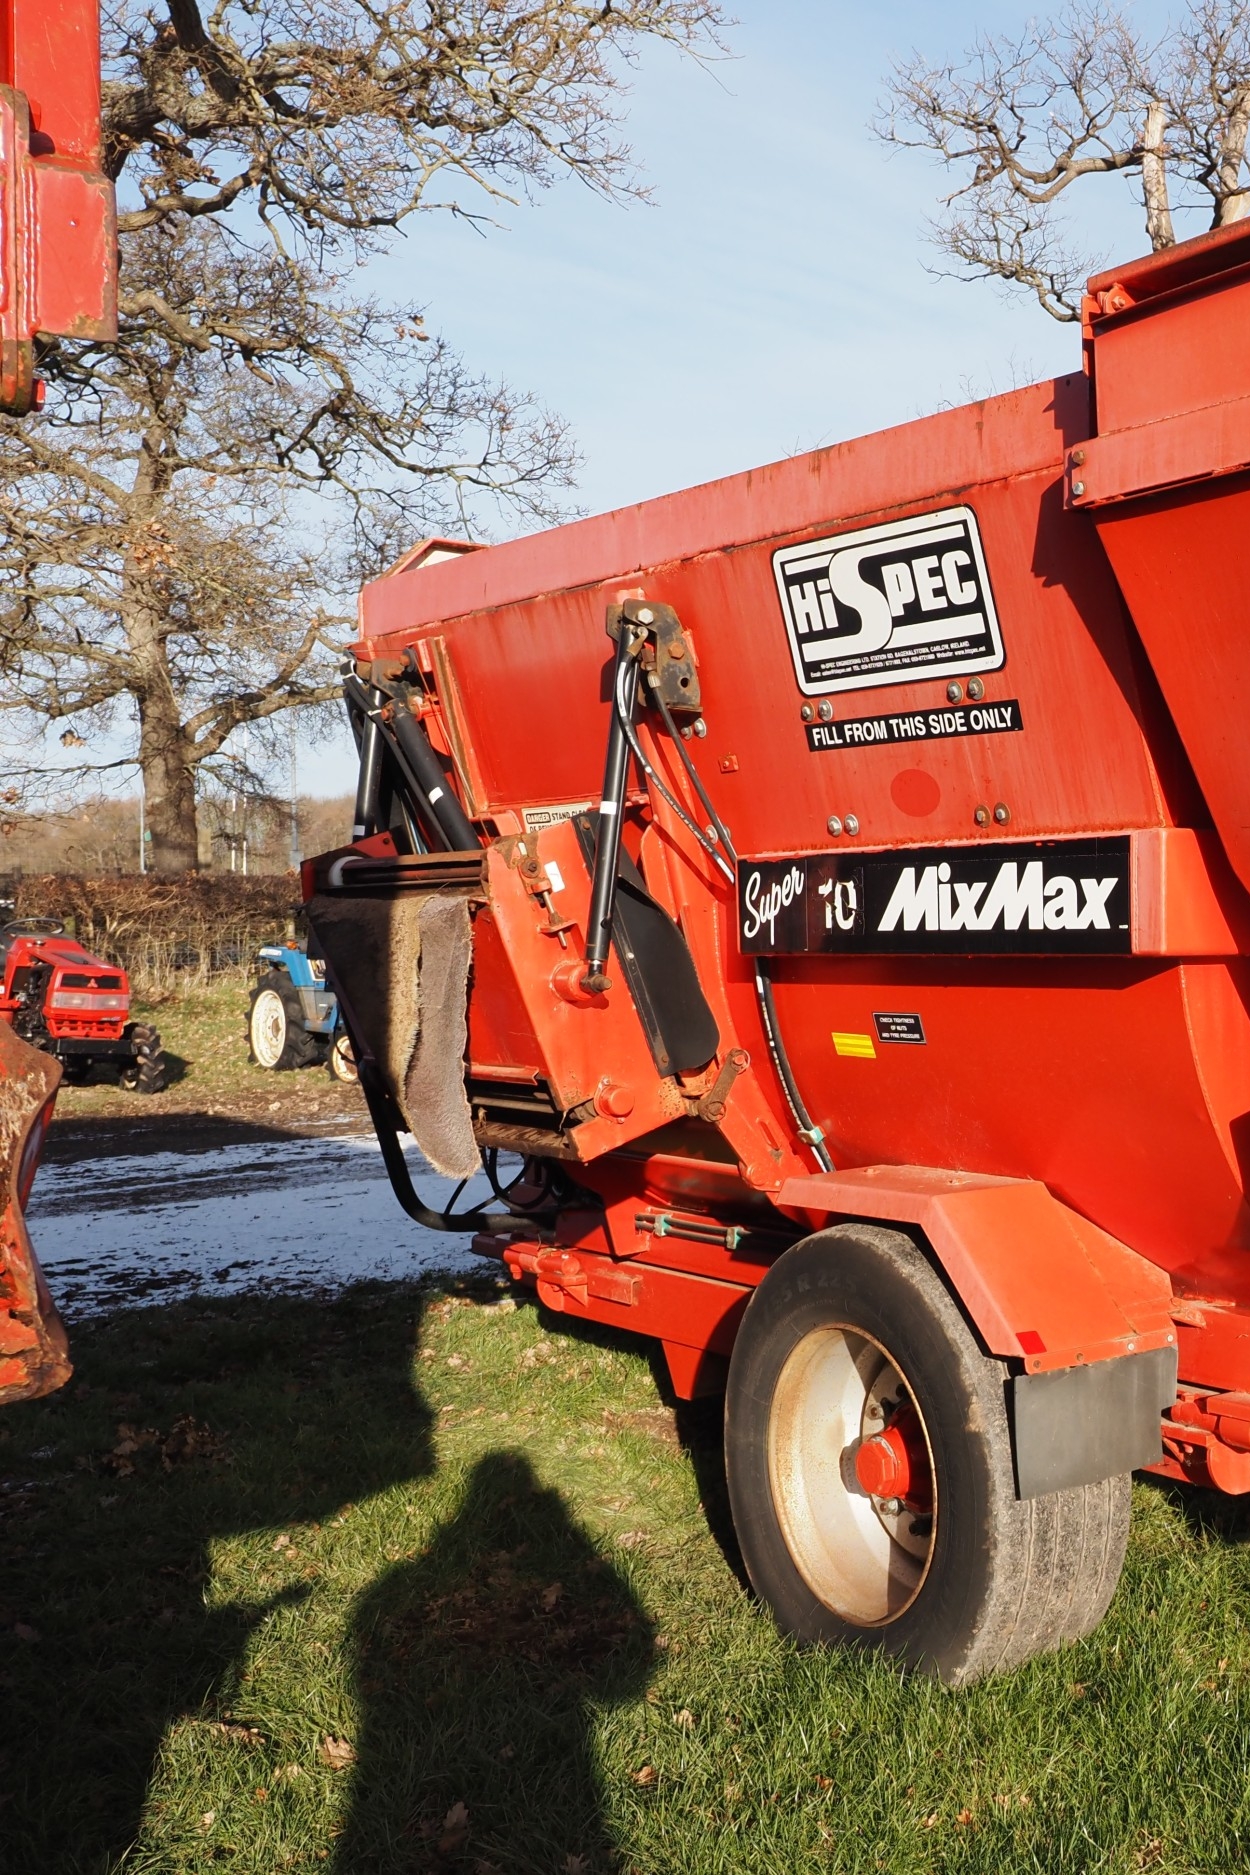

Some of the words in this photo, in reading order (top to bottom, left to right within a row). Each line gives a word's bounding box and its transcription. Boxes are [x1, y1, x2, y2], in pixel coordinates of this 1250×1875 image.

[812, 725, 844, 747] FILL
[843, 720, 888, 743] FROM
[889, 715, 927, 738] THIS
[929, 711, 968, 735] SIDE
[969, 706, 1012, 731] ONLY
[551, 811, 570, 821] STAND
[743, 866, 805, 946] Super
[818, 878, 857, 931] 10
[877, 861, 1119, 932] MixMax
